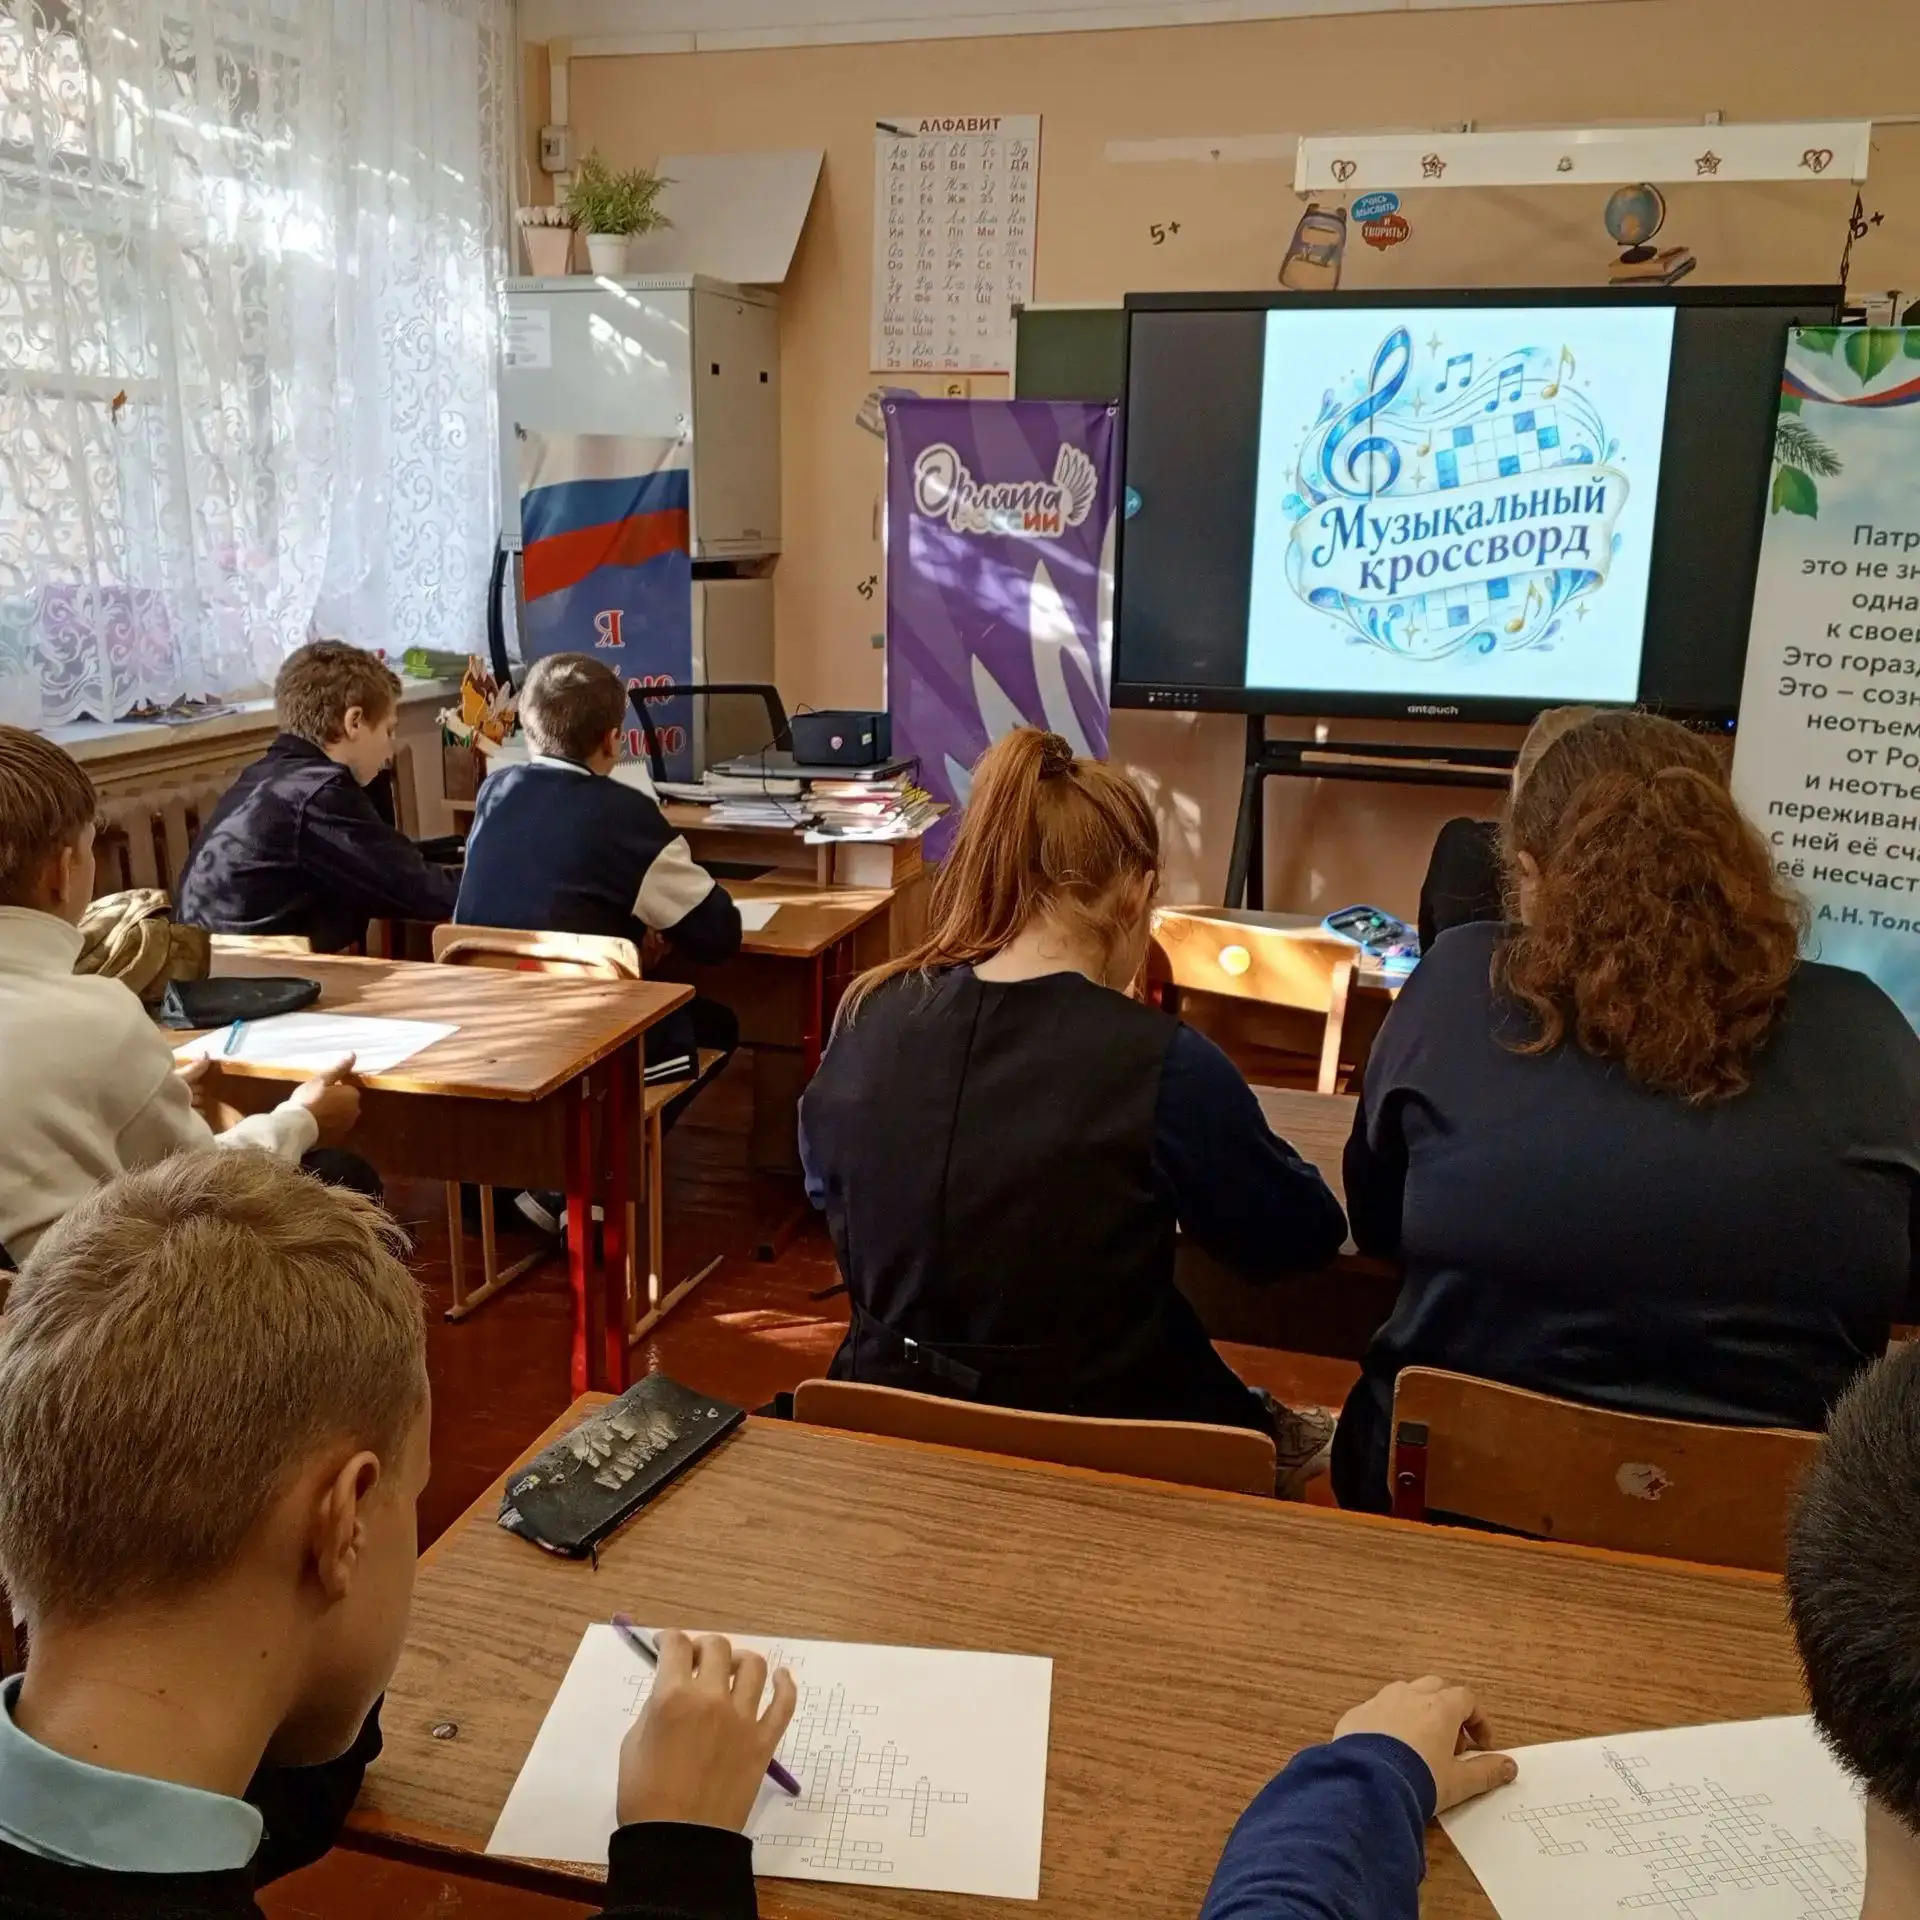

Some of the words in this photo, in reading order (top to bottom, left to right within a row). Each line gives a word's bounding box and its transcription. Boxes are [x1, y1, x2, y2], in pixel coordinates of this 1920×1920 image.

[919, 118, 1002, 133] АЛФАВИТ
[1356, 203, 1395, 217] МЫСЛИТЬ
[1361, 196, 1387, 206] УЧИСЬ
[1365, 227, 1406, 238] ТВОРИТЬ!
[919, 448, 1062, 520] Орлята
[1311, 476, 1607, 568] Музыкальный
[1854, 525, 1920, 552] Патр
[1359, 524, 1590, 594] кроссворд
[1802, 559, 1847, 576] это
[1856, 562, 1888, 578] не
[594, 609, 625, 648] Я
[1827, 623, 1842, 638] к
[1783, 646, 1832, 668] Это
[1778, 676, 1828, 699] Это
[1807, 714, 1920, 738] неотъем
[1847, 748, 1878, 764] от
[1886, 747, 1920, 773] Ро
[1805, 774, 1821, 790] и
[1769, 800, 1920, 830] переживан
[1771, 830, 1784, 845] с
[1792, 832, 1840, 852] ней
[1847, 837, 1878, 856] её
[1776, 858, 1805, 878] её
[1813, 865, 1920, 892] несчаст
[1818, 904, 1863, 925] А.Н.
